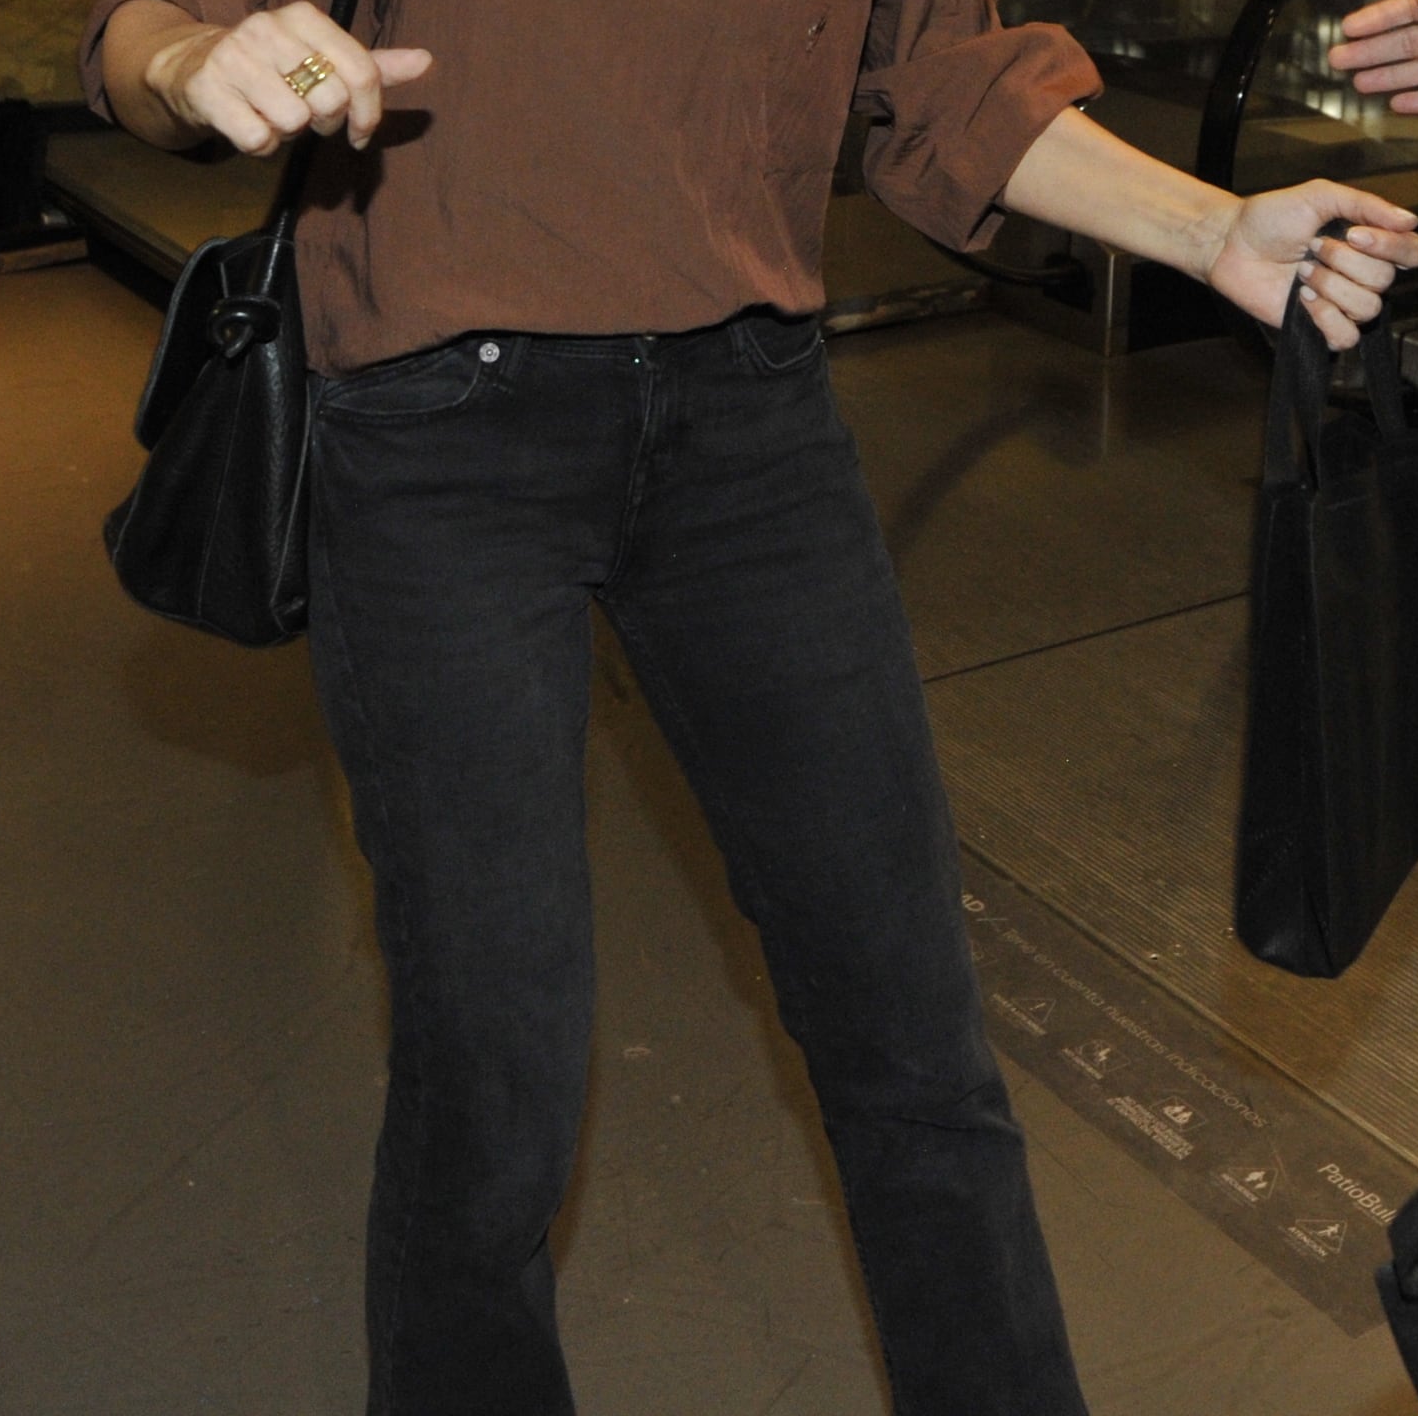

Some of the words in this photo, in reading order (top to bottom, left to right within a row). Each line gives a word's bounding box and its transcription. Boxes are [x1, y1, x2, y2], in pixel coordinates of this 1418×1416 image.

[1053, 968, 1105, 1006] cuenta
[1103, 1005, 1169, 1054] nuestras
[1165, 1053, 1267, 1127] indicaciones
